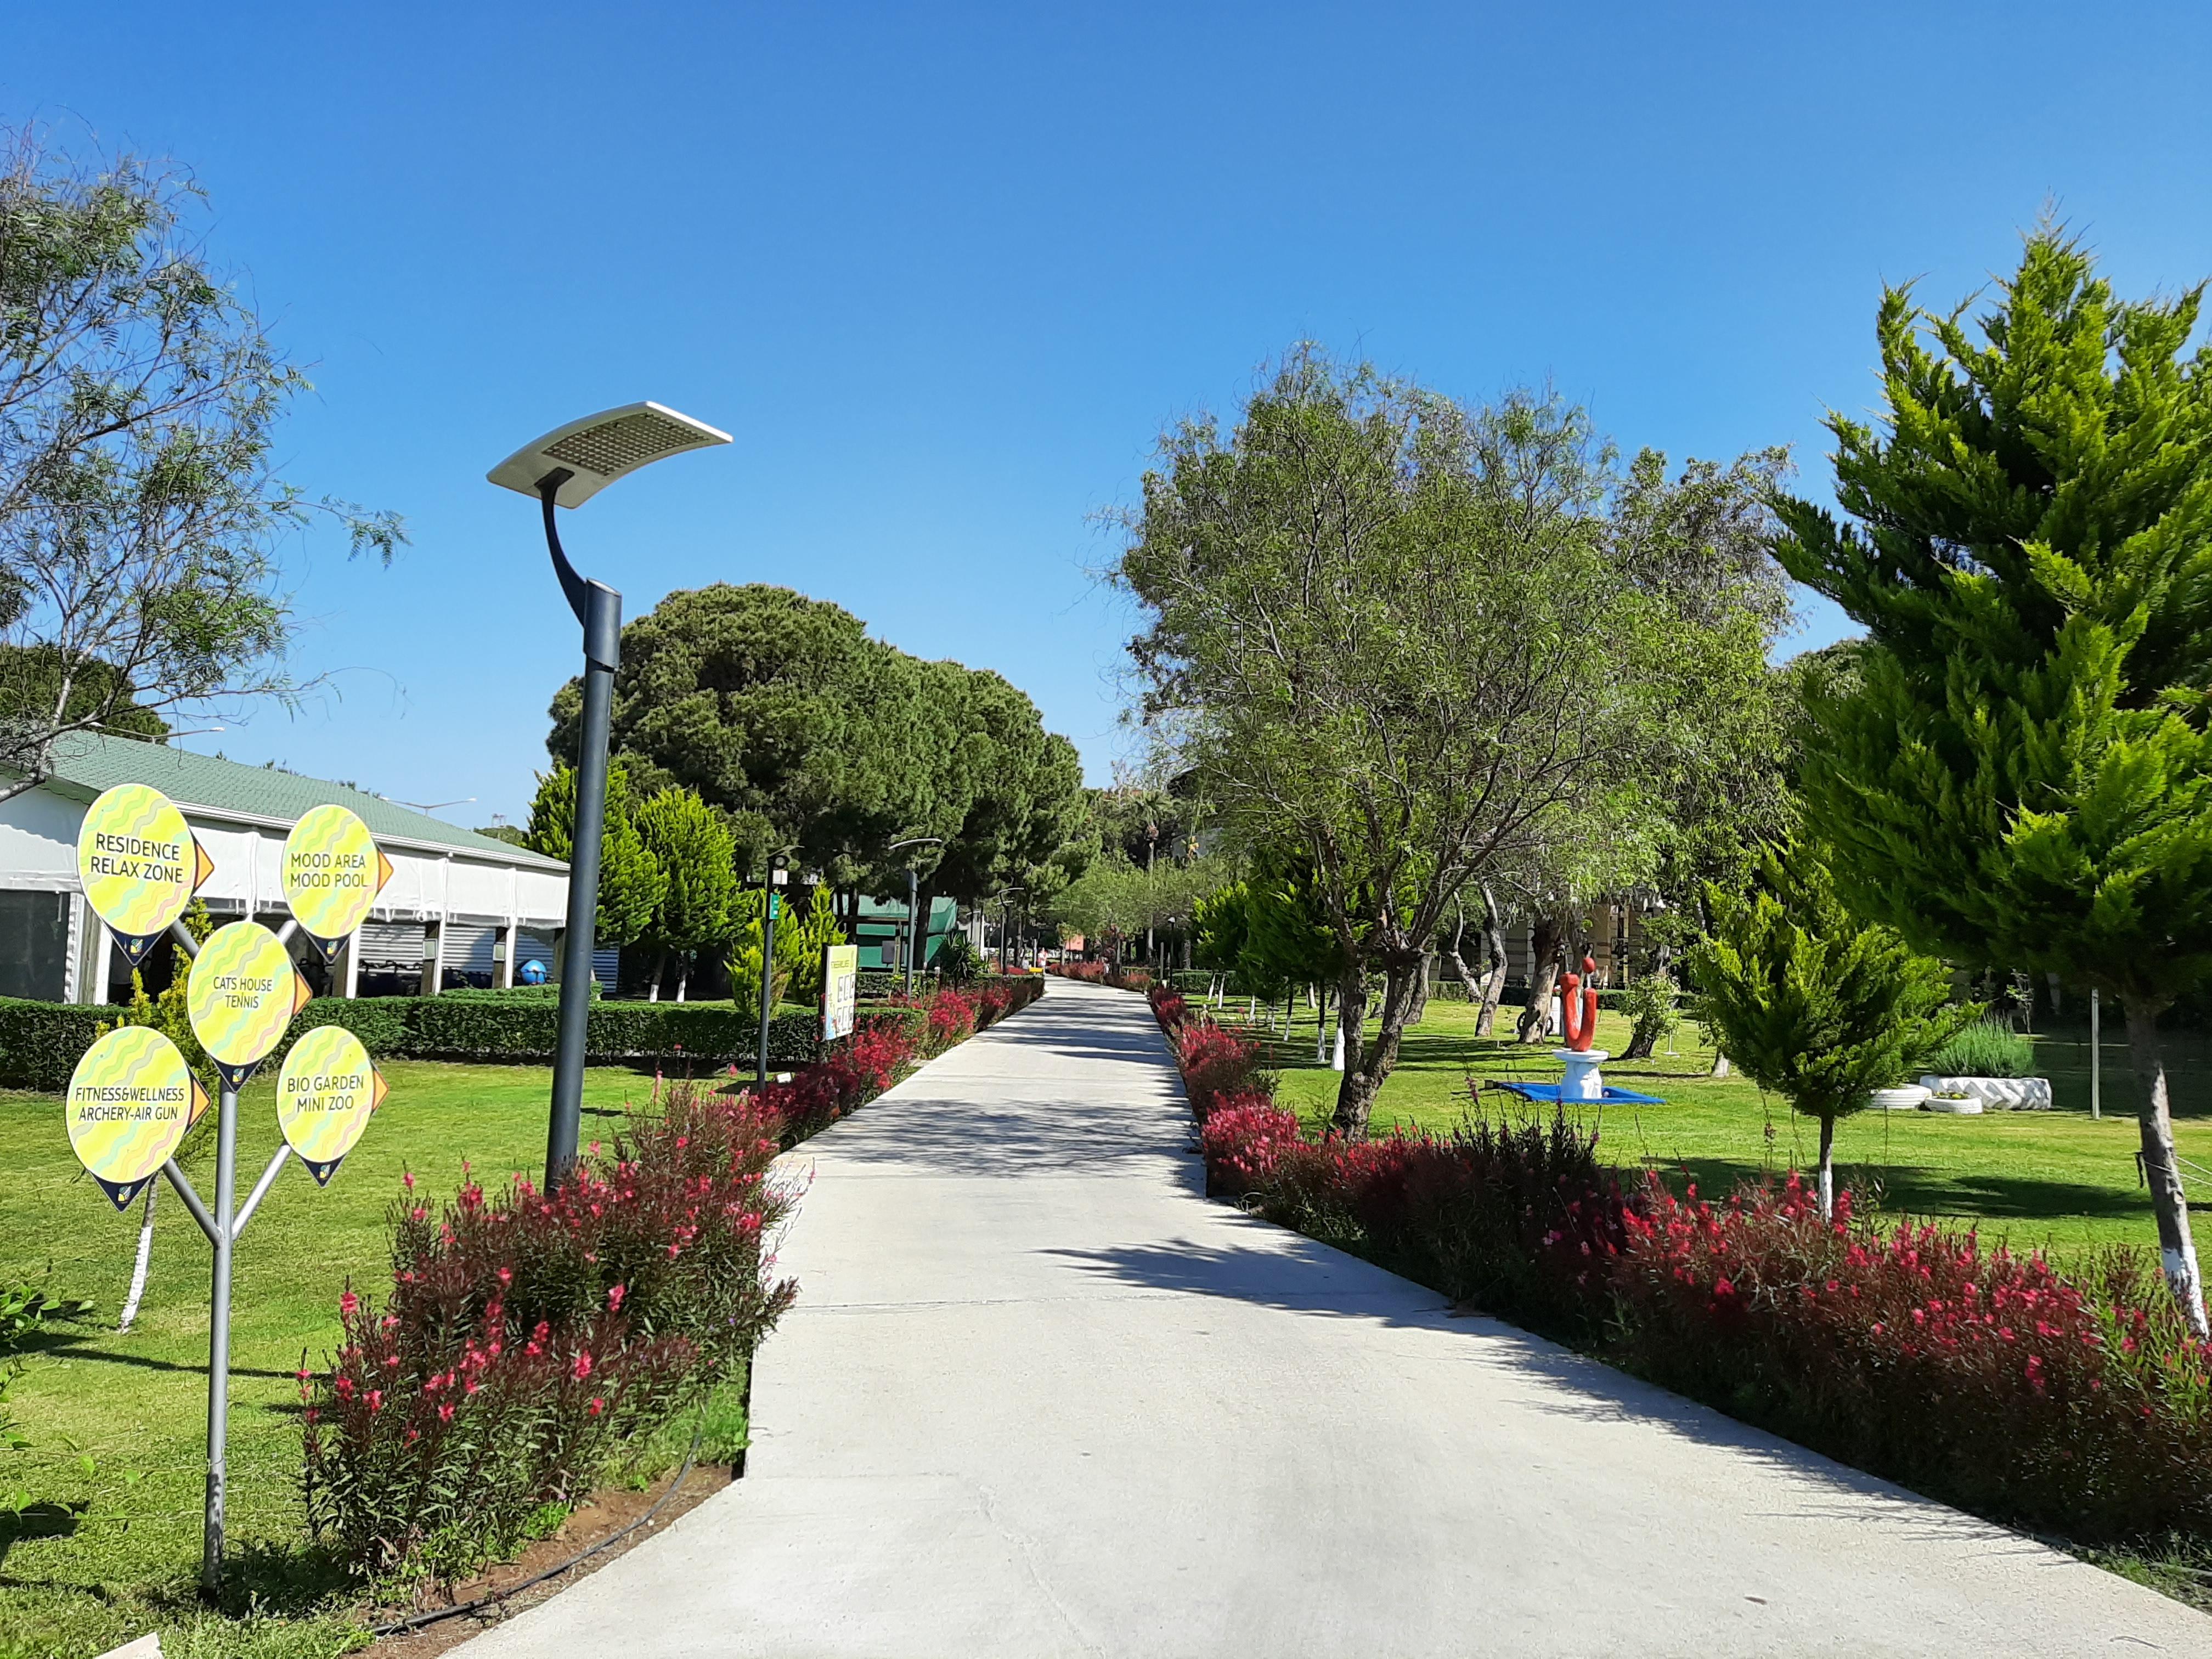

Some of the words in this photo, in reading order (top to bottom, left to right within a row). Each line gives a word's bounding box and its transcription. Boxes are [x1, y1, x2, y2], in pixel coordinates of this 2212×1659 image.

[96, 832, 179, 861] RESIDENCE
[291, 853, 331, 868] MOOD
[334, 854, 366, 868] AREA
[91, 856, 139, 878] RELAX
[143, 864, 183, 883] ZONE
[290, 873, 330, 888] MOOD
[335, 874, 369, 888] POOL
[213, 977, 237, 990] CATS
[240, 978, 272, 991] HOUSE
[225, 992, 259, 1008] TENNIS
[287, 1077, 310, 1092] BIO
[314, 1075, 364, 1091] GARDEN
[76, 1087, 185, 1101] FITNESS&WELLNESS
[297, 1097, 324, 1113] MINI
[328, 1095, 354, 1110] ZOO
[78, 1107, 152, 1121] ARCHERY-AIR
[155, 1107, 178, 1120] GUN
